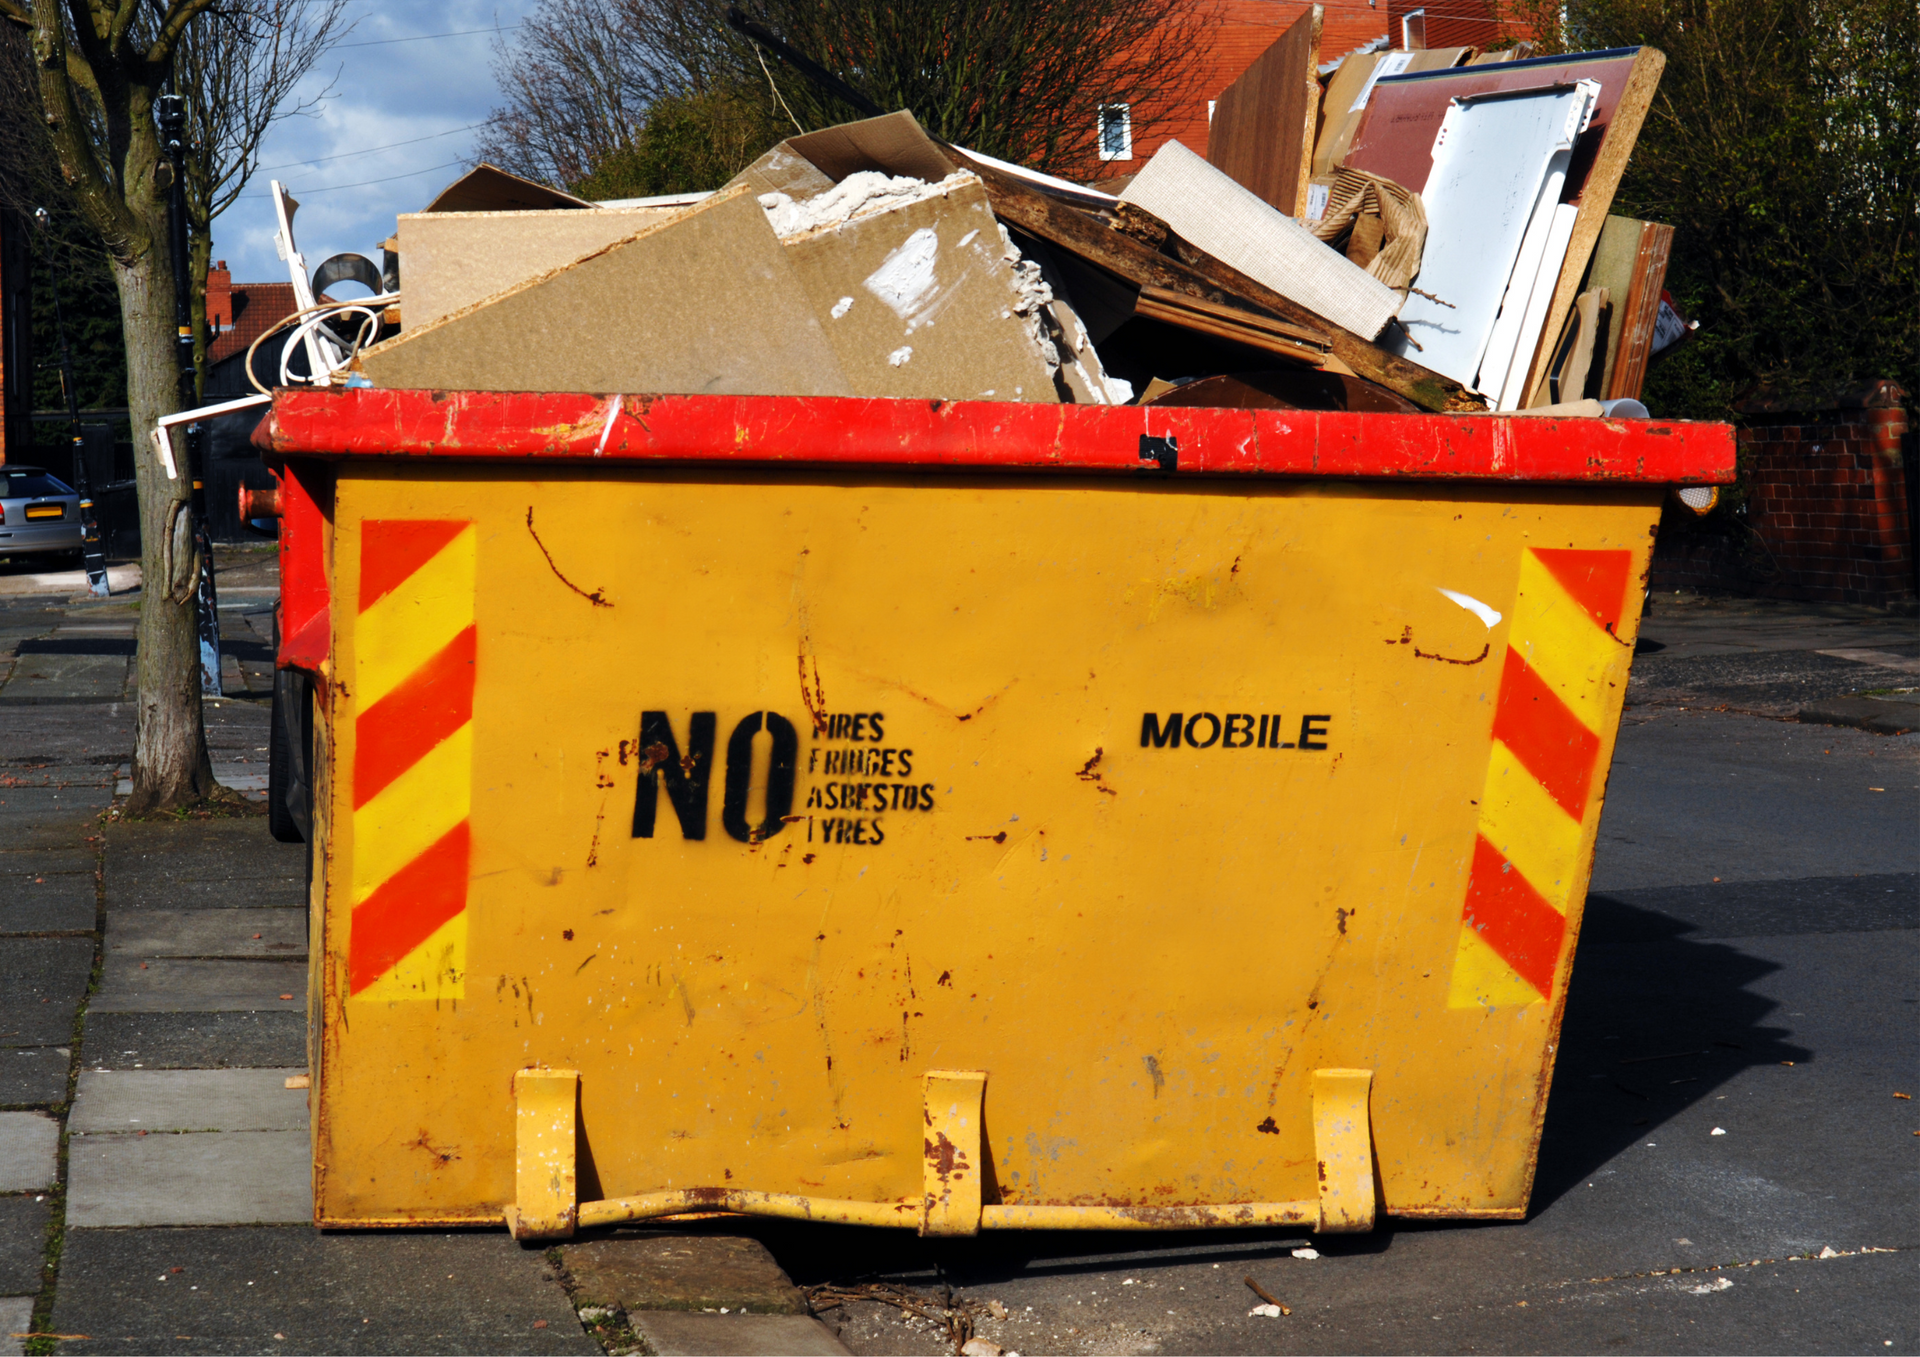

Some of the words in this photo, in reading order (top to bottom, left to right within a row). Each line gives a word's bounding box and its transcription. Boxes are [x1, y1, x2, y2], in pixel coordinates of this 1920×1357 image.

[812, 712, 885, 742] FIRES
[1140, 712, 1331, 749] MOBILE
[632, 710, 798, 843] NO
[807, 782, 935, 812] ASBESTOS
